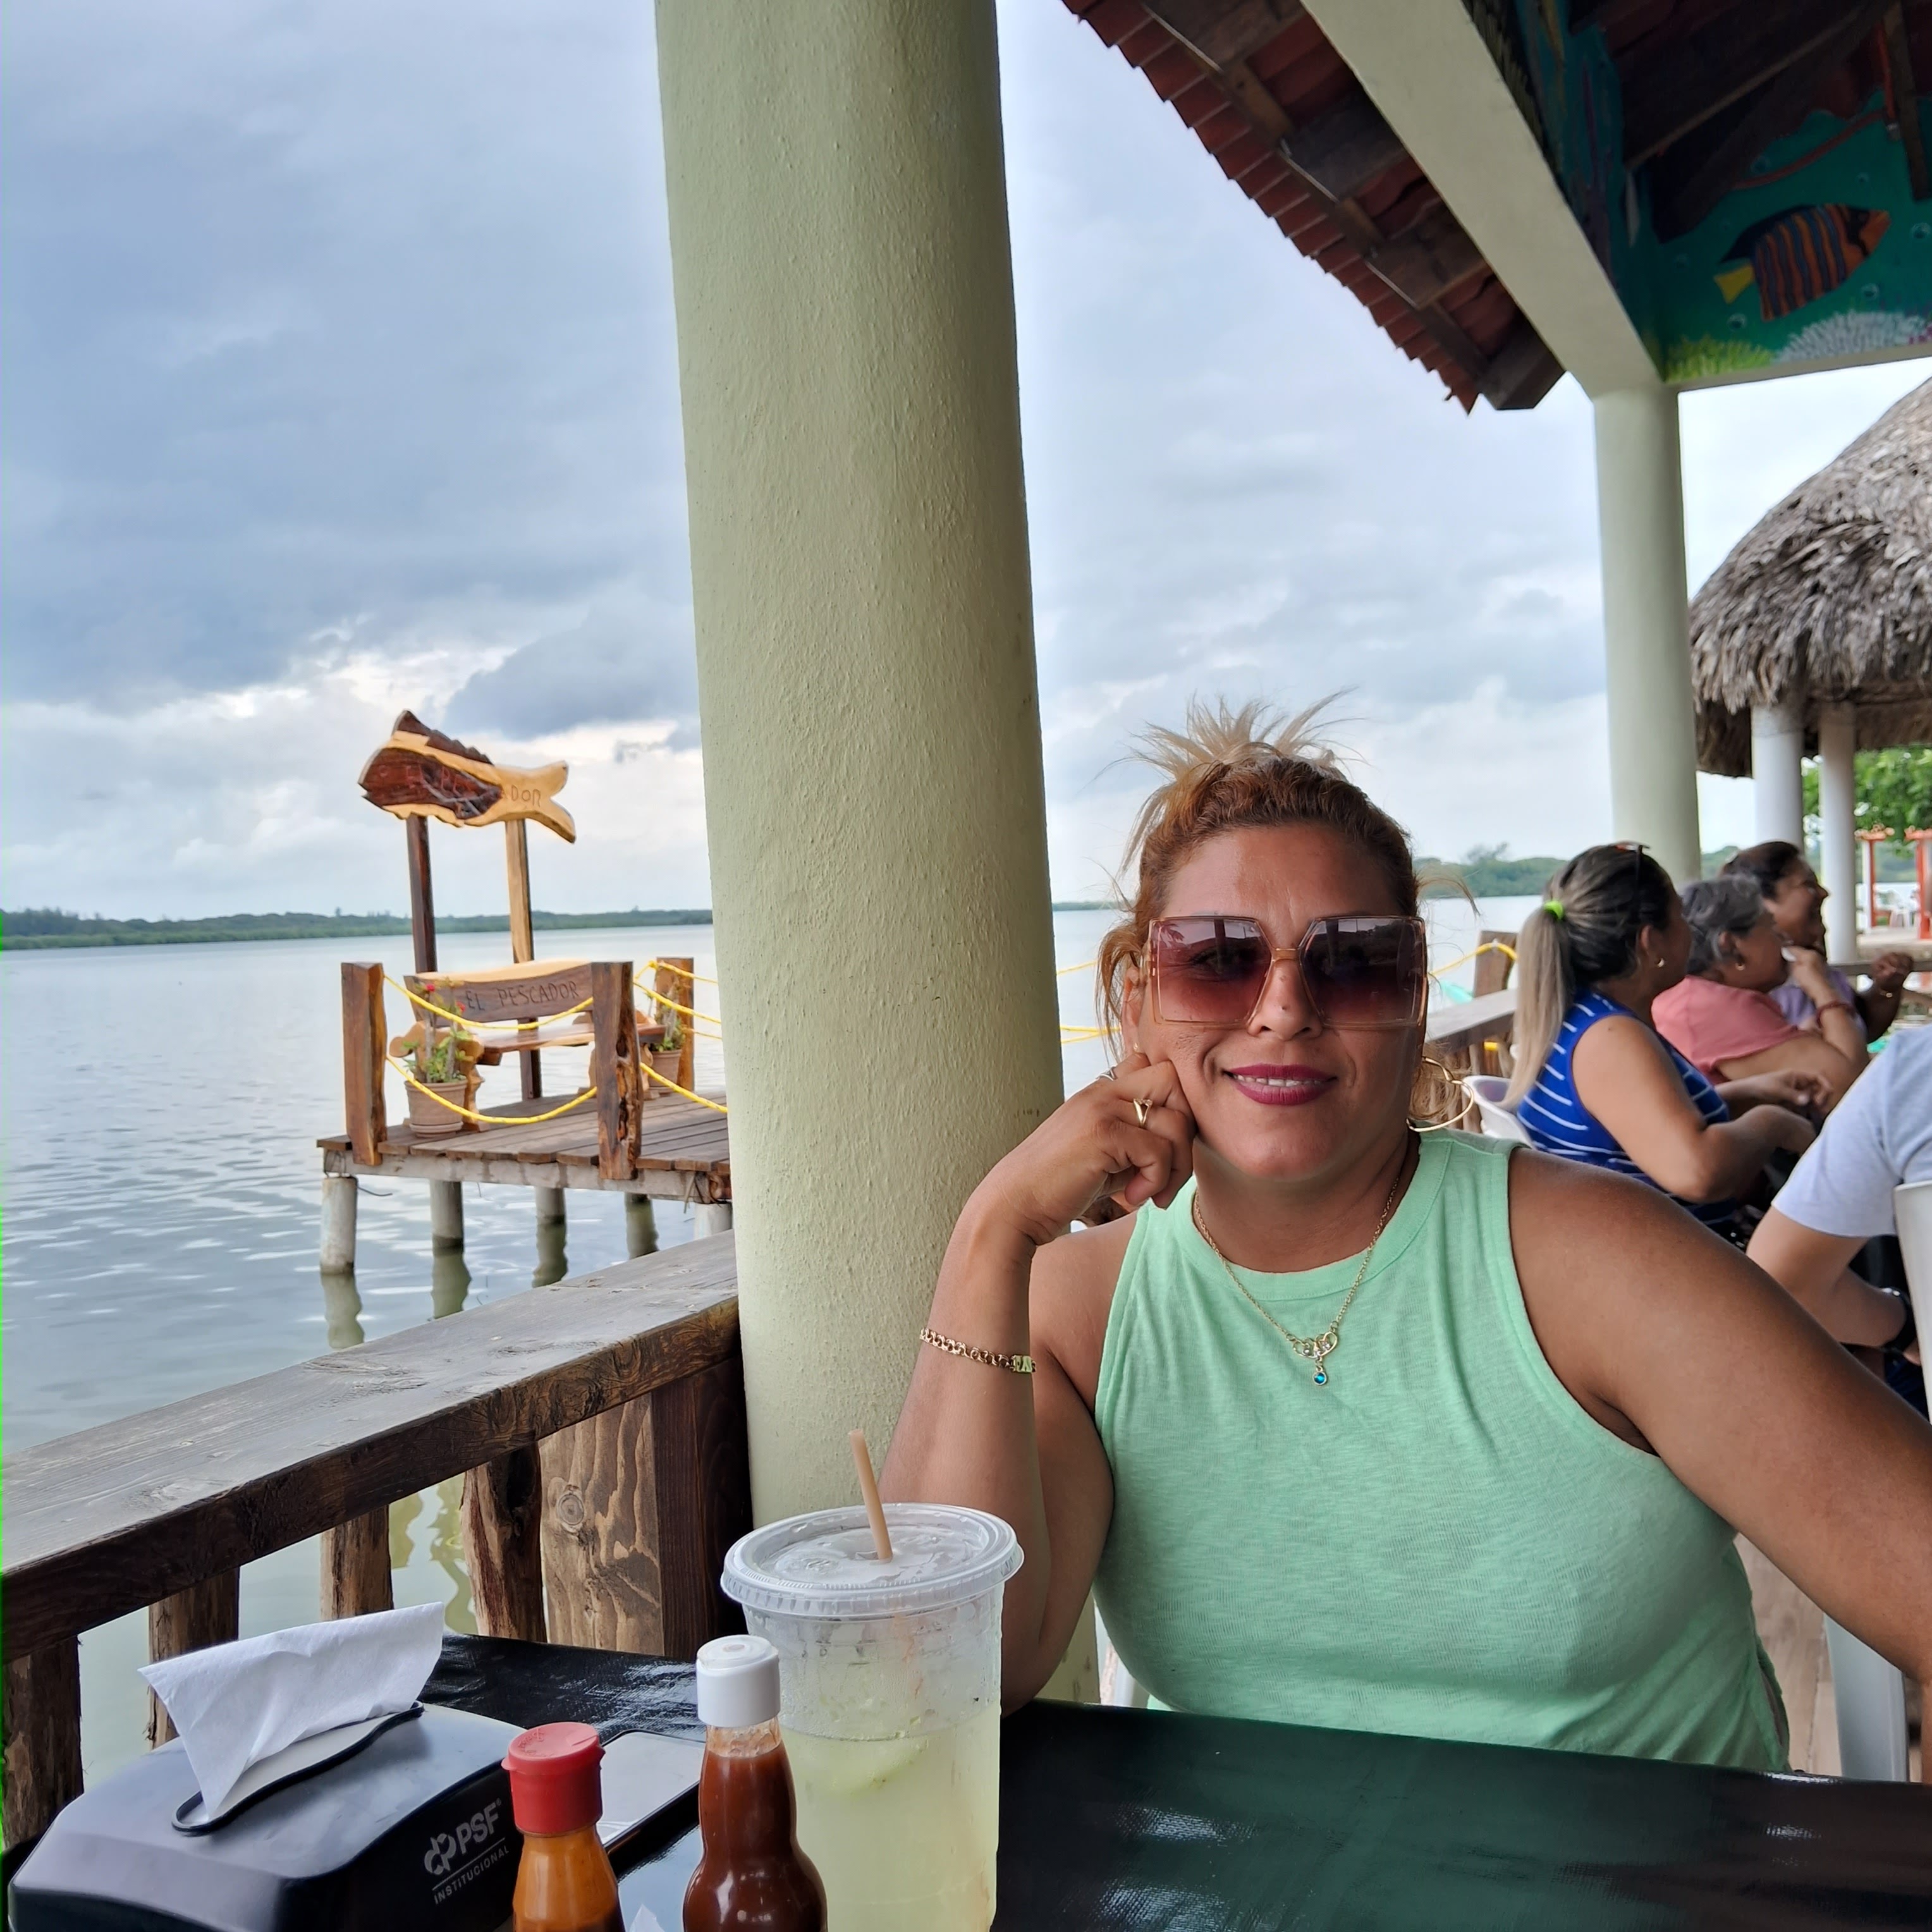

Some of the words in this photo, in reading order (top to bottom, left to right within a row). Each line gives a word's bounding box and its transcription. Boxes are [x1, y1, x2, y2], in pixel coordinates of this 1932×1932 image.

[465, 990, 485, 1011] EL
[496, 981, 579, 1007] PESCADOR
[434, 1845, 510, 1905] INSTITUCIONAL
